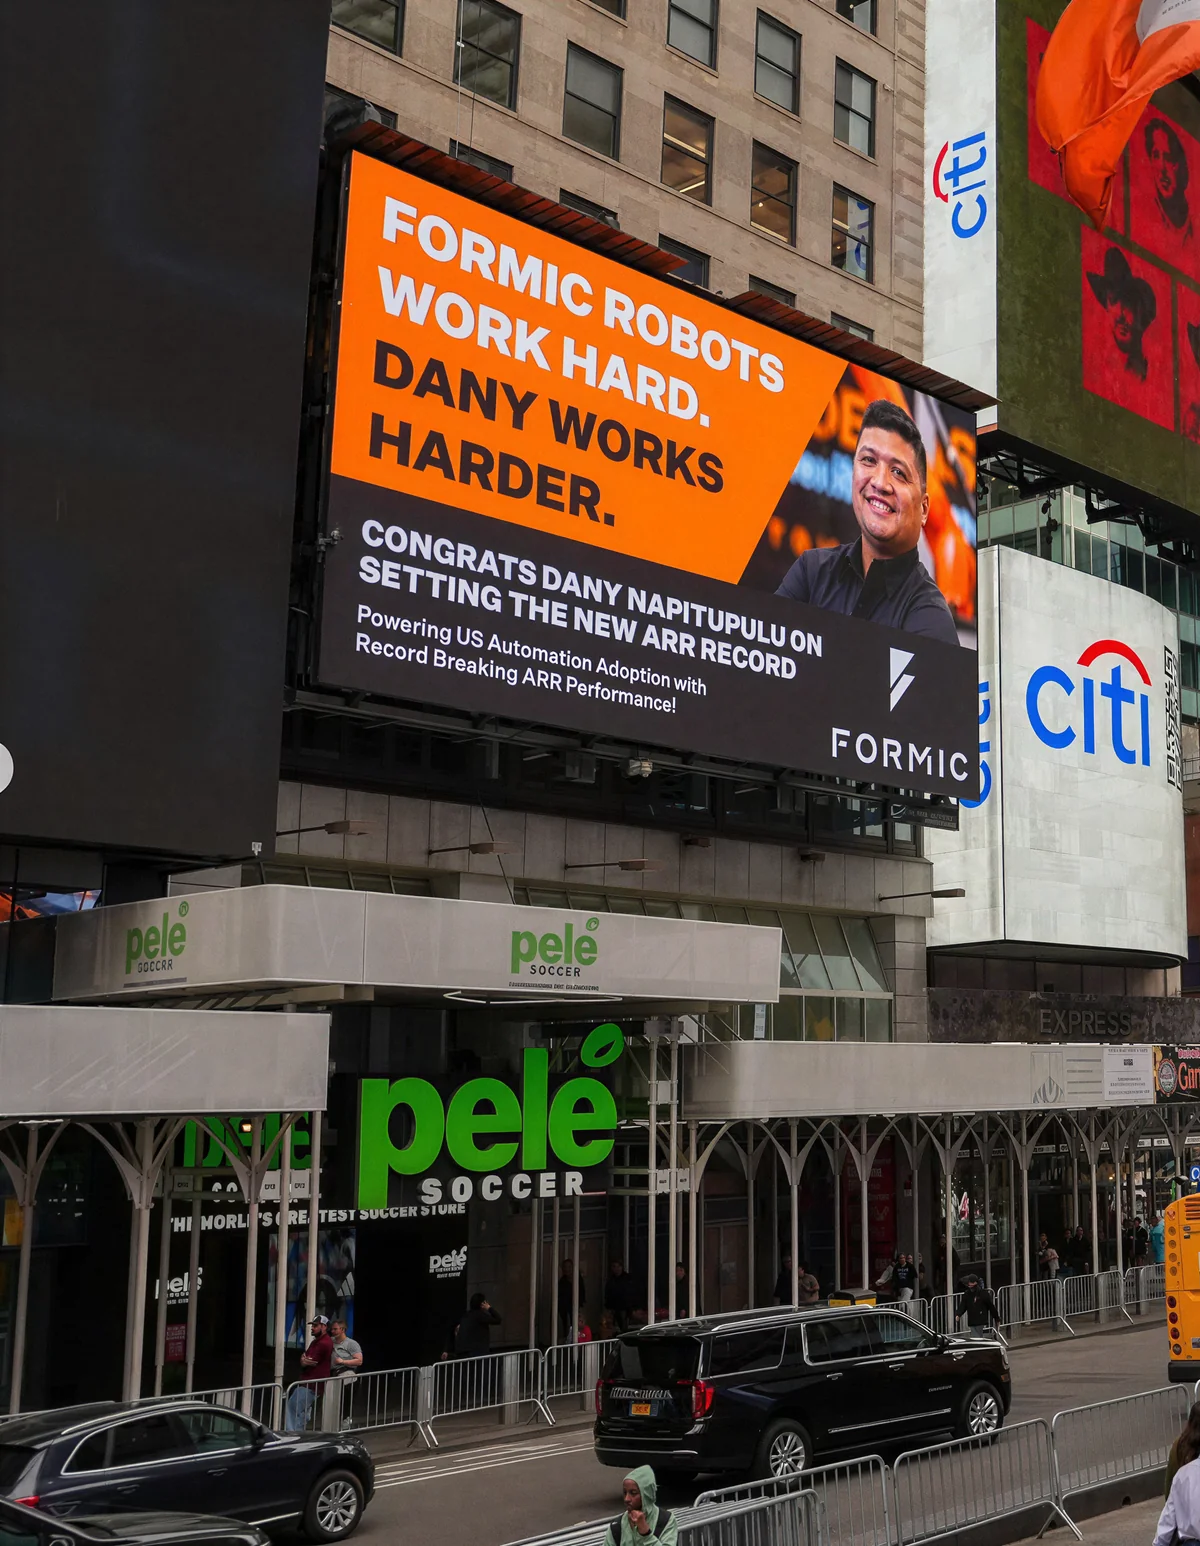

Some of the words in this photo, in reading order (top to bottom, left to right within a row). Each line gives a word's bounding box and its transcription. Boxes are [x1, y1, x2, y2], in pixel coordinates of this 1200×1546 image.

[378, 266, 551, 371] WORK
[562, 336, 710, 428] HARD.
[382, 196, 594, 317] FORMIC
[604, 287, 786, 393] ROBOTS
[369, 412, 616, 526] HARDER.
[374, 339, 539, 431] DANY
[549, 397, 725, 494] WORKS
[358, 555, 502, 613] SETTING
[509, 591, 568, 629] THE
[573, 607, 638, 646] NEW
[641, 625, 696, 657] ARR
[701, 641, 798, 680] RECORD
[361, 519, 537, 586] CONGRATS
[542, 563, 622, 606] DANY
[627, 586, 787, 649] NAPITUPULU
[790, 631, 823, 657] ON
[356, 632, 429, 669] Record
[433, 649, 518, 686] Breaking
[522, 667, 563, 691] ARR
[566, 675, 677, 714] Performance!
[357, 604, 453, 647] Powering
[456, 625, 484, 649] US
[488, 632, 593, 673] Automation
[596, 654, 671, 689] Adoption
[674, 673, 708, 696] with
[831, 727, 969, 783] FORMIC
[1026, 662, 1151, 767] citi
[530, 964, 581, 977] SOCCER
[1040, 1009, 1132, 1036] EXPRESS
[357, 1023, 625, 1210] pelé
[420, 1171, 584, 1204] SOCCER
